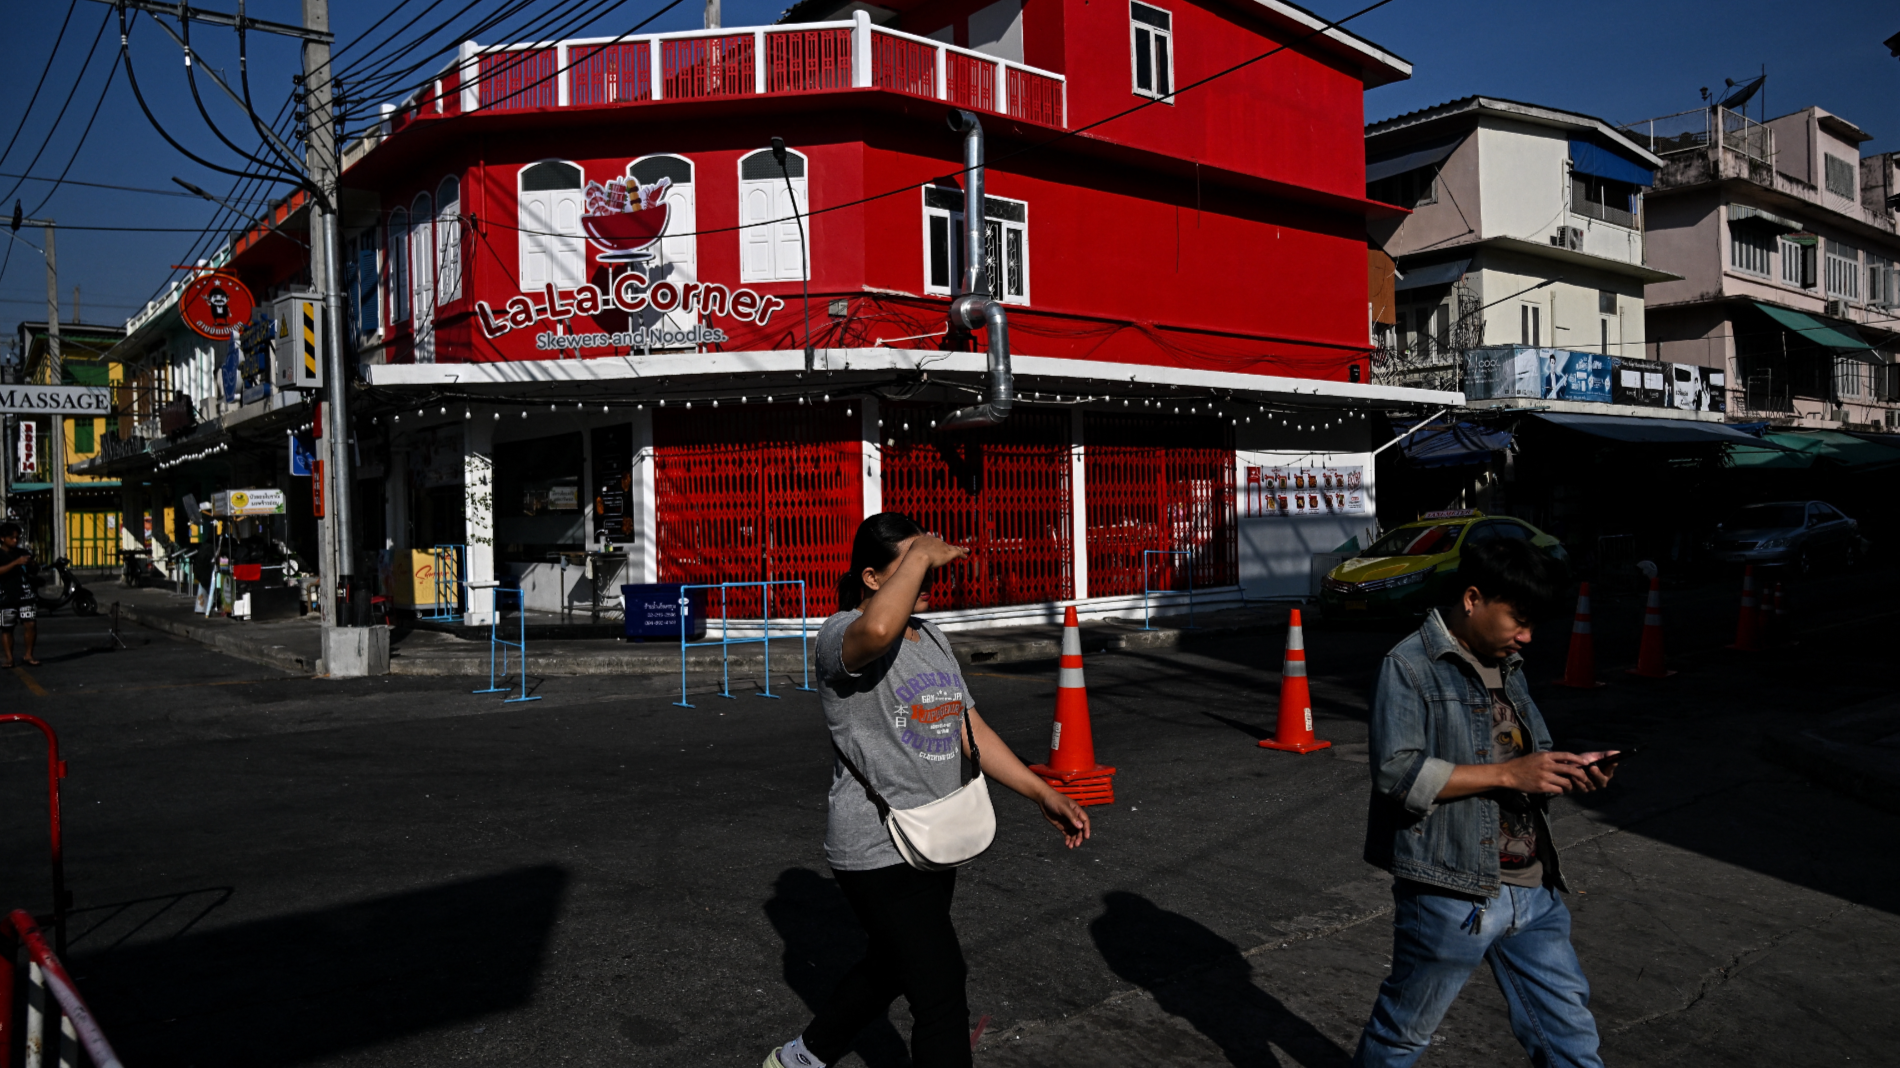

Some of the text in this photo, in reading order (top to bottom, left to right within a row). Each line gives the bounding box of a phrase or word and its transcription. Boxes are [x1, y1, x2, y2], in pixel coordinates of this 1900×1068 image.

[475, 271, 784, 339] La La Corner
[536, 329, 610, 350] Skewers
[611, 327, 648, 346] and
[0, 390, 109, 410] MASSAGE
[23, 462, 34, 471] 14
